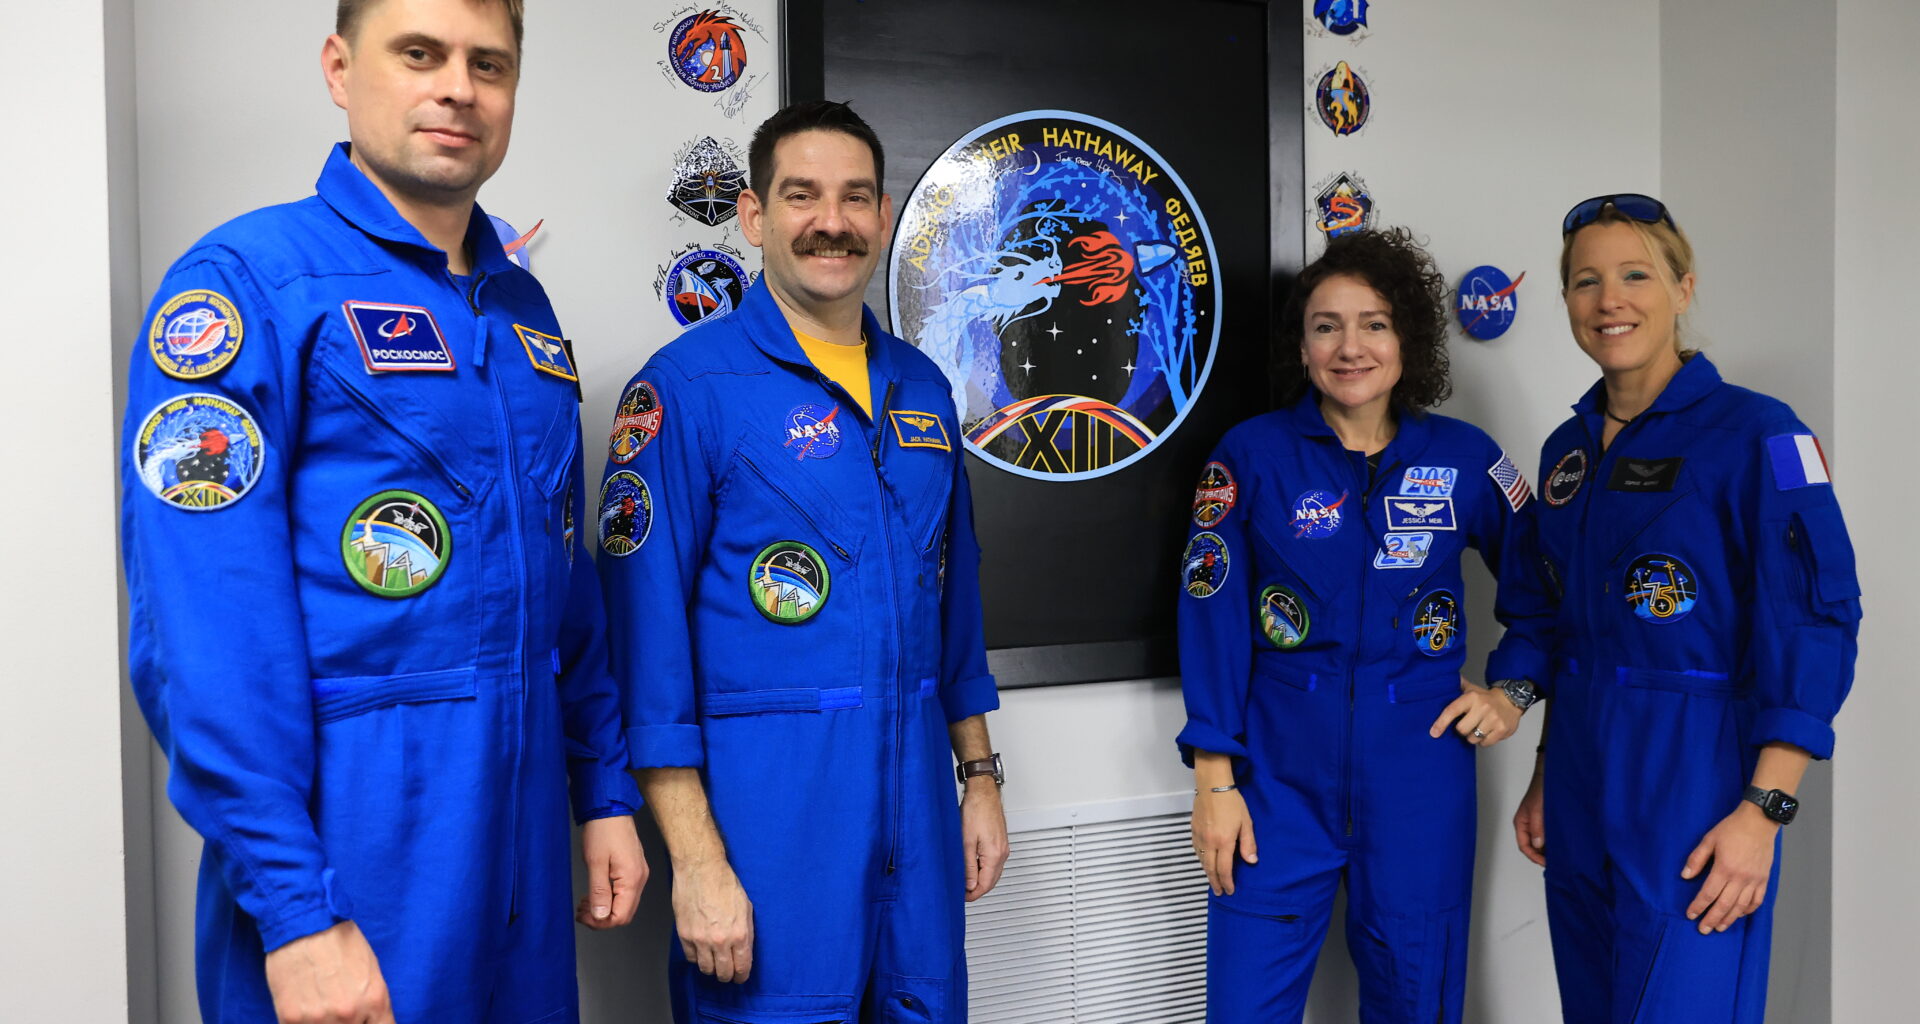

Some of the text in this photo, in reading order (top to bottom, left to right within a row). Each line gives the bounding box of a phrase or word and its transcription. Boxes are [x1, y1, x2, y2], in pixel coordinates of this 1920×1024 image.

[711, 65, 722, 81] 2
[1042, 127, 1159, 186] HATHAWAY
[679, 202, 701, 220] WATKINS
[1165, 197, 1208, 287] ФЕДЯЕВ
[679, 252, 706, 268] HOBURG
[1461, 294, 1515, 312] NASA
[372, 348, 446, 362] РОСКОСМОС
[787, 421, 840, 442] NASA
[1295, 508, 1341, 521] NASA
[1402, 517, 1443, 525] JESSICA MEIR
[1642, 581, 1677, 618] 75
